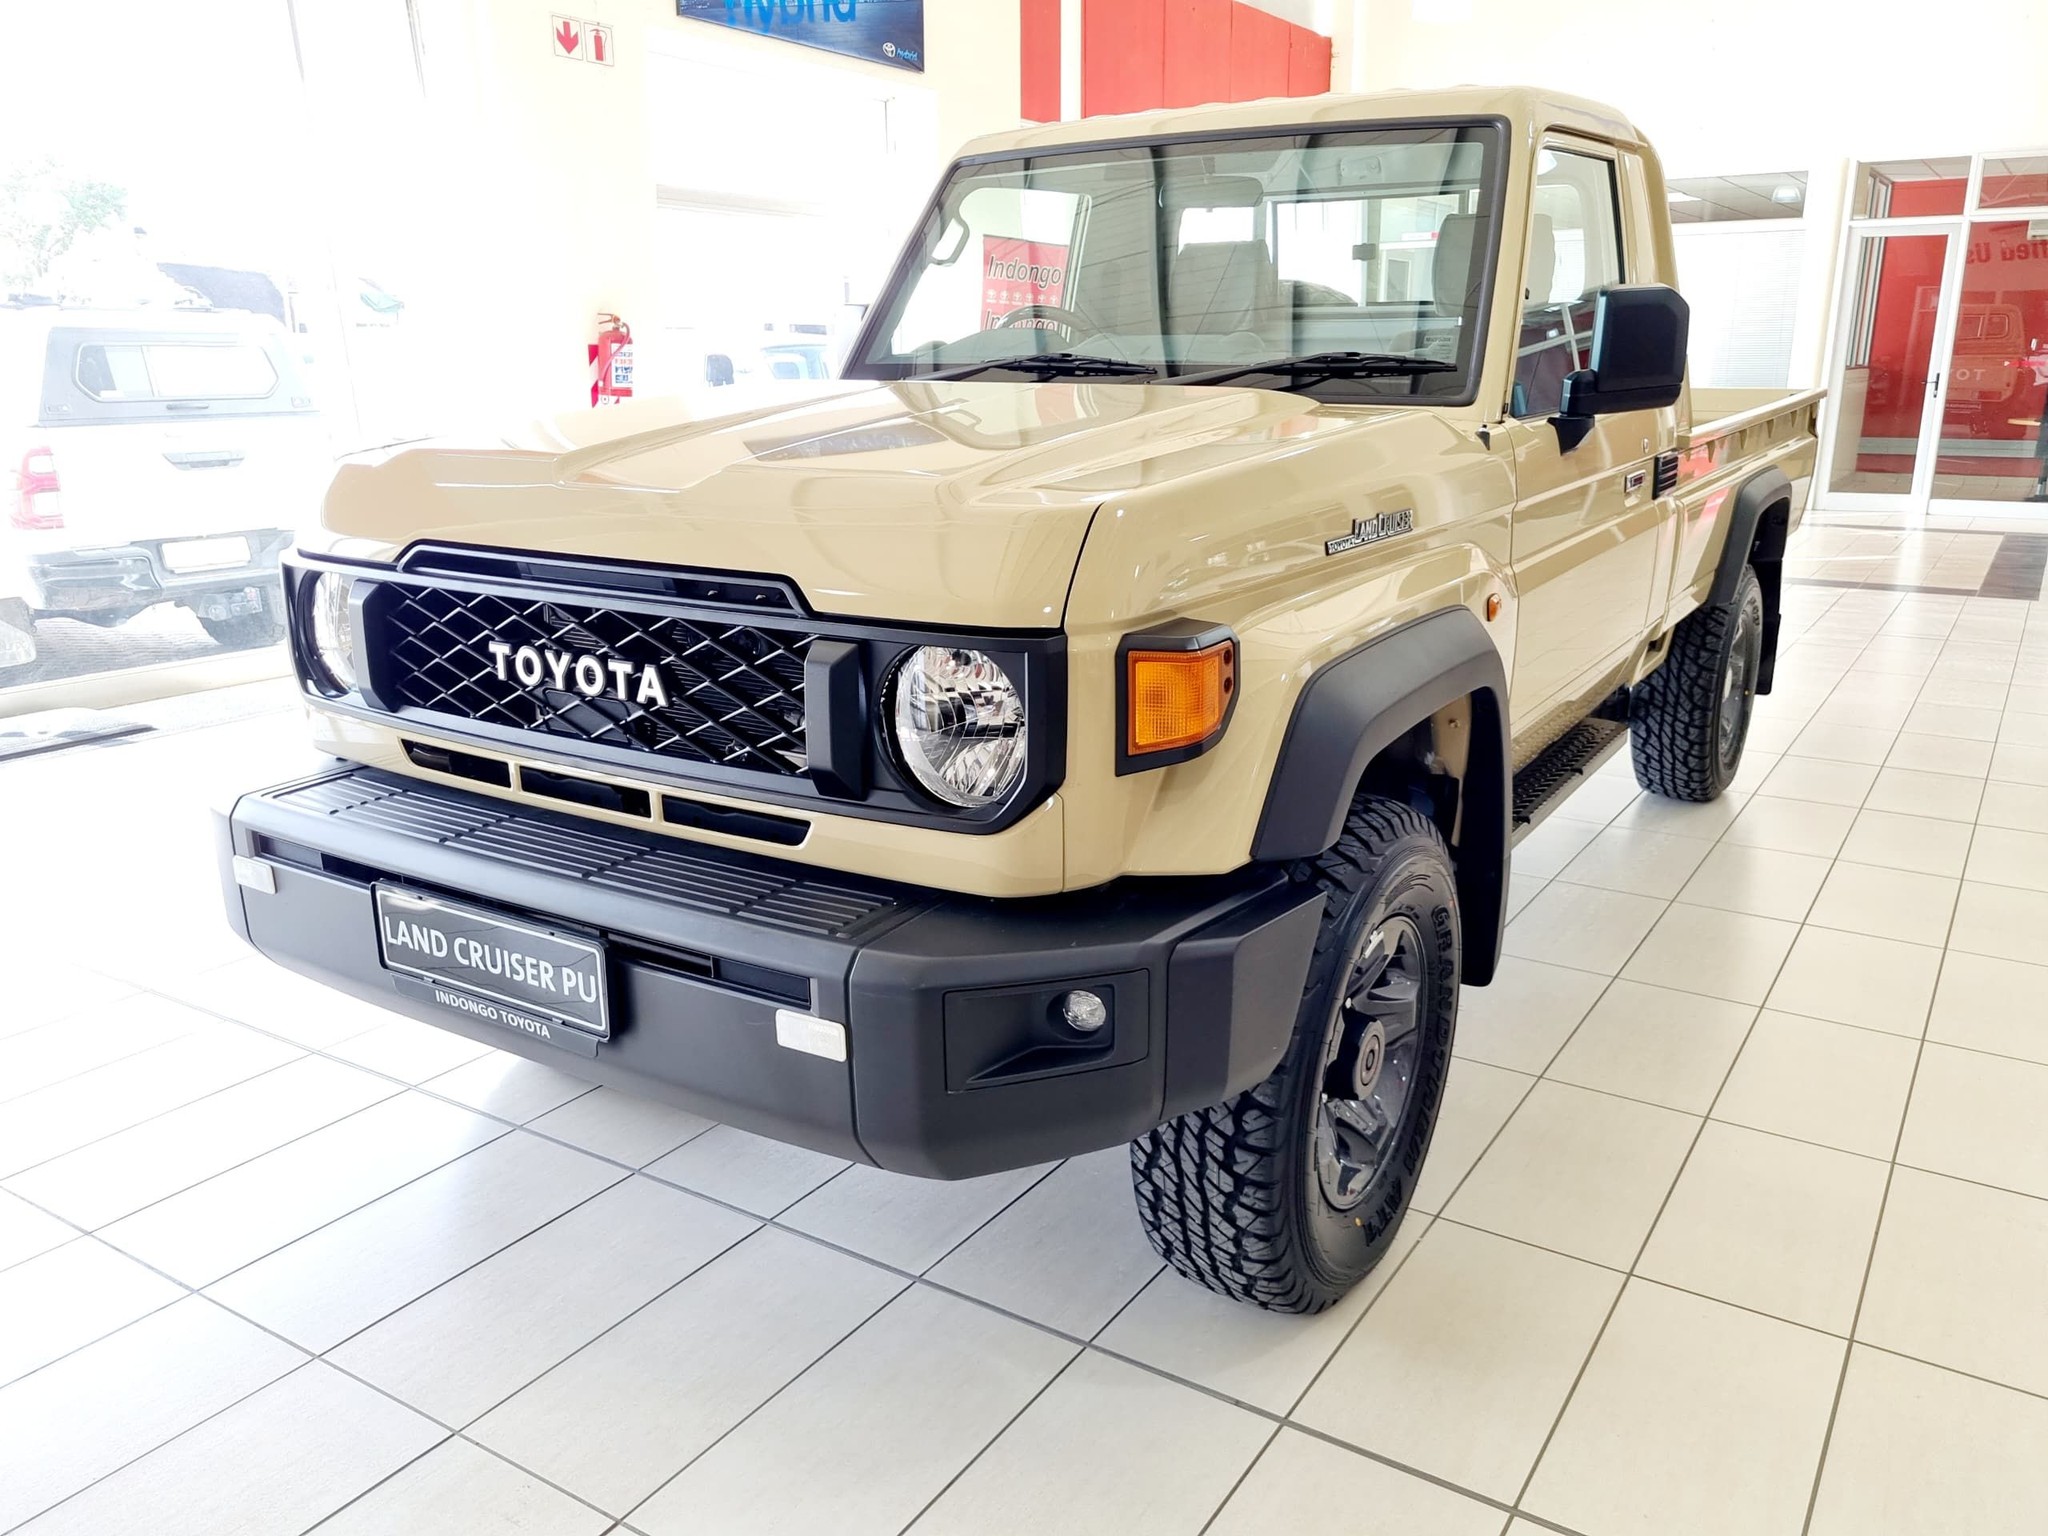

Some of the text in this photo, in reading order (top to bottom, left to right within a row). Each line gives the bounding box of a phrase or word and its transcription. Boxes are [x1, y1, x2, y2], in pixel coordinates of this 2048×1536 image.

[987, 255, 1062, 289] Indongo
[1328, 537, 1355, 552] TOYOTA
[488, 640, 669, 708] TOYOTA
[384, 915, 598, 1003] LAND CRUISER PU
[435, 989, 551, 1039] INDONGO TOYOTA
